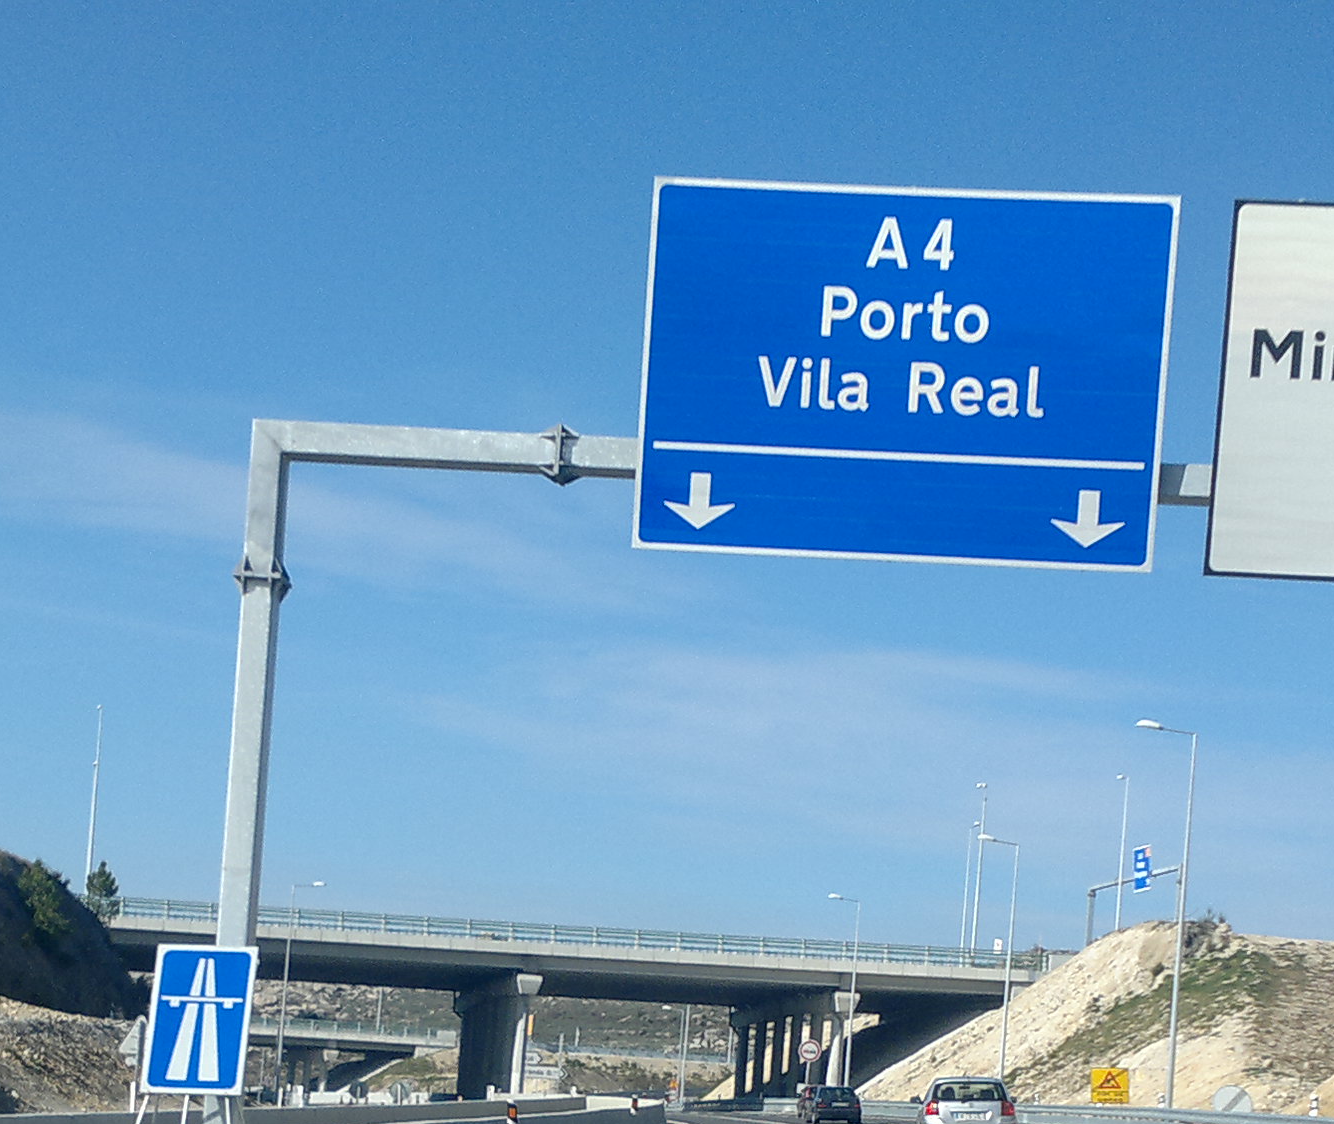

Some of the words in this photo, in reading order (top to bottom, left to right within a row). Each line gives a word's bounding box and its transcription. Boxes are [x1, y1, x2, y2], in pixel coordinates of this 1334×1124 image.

[866, 216, 909, 269] A
[923, 218, 955, 271] 4
[820, 285, 990, 344] Porto
[758, 355, 869, 412] Vila
[907, 361, 1044, 418] Real
